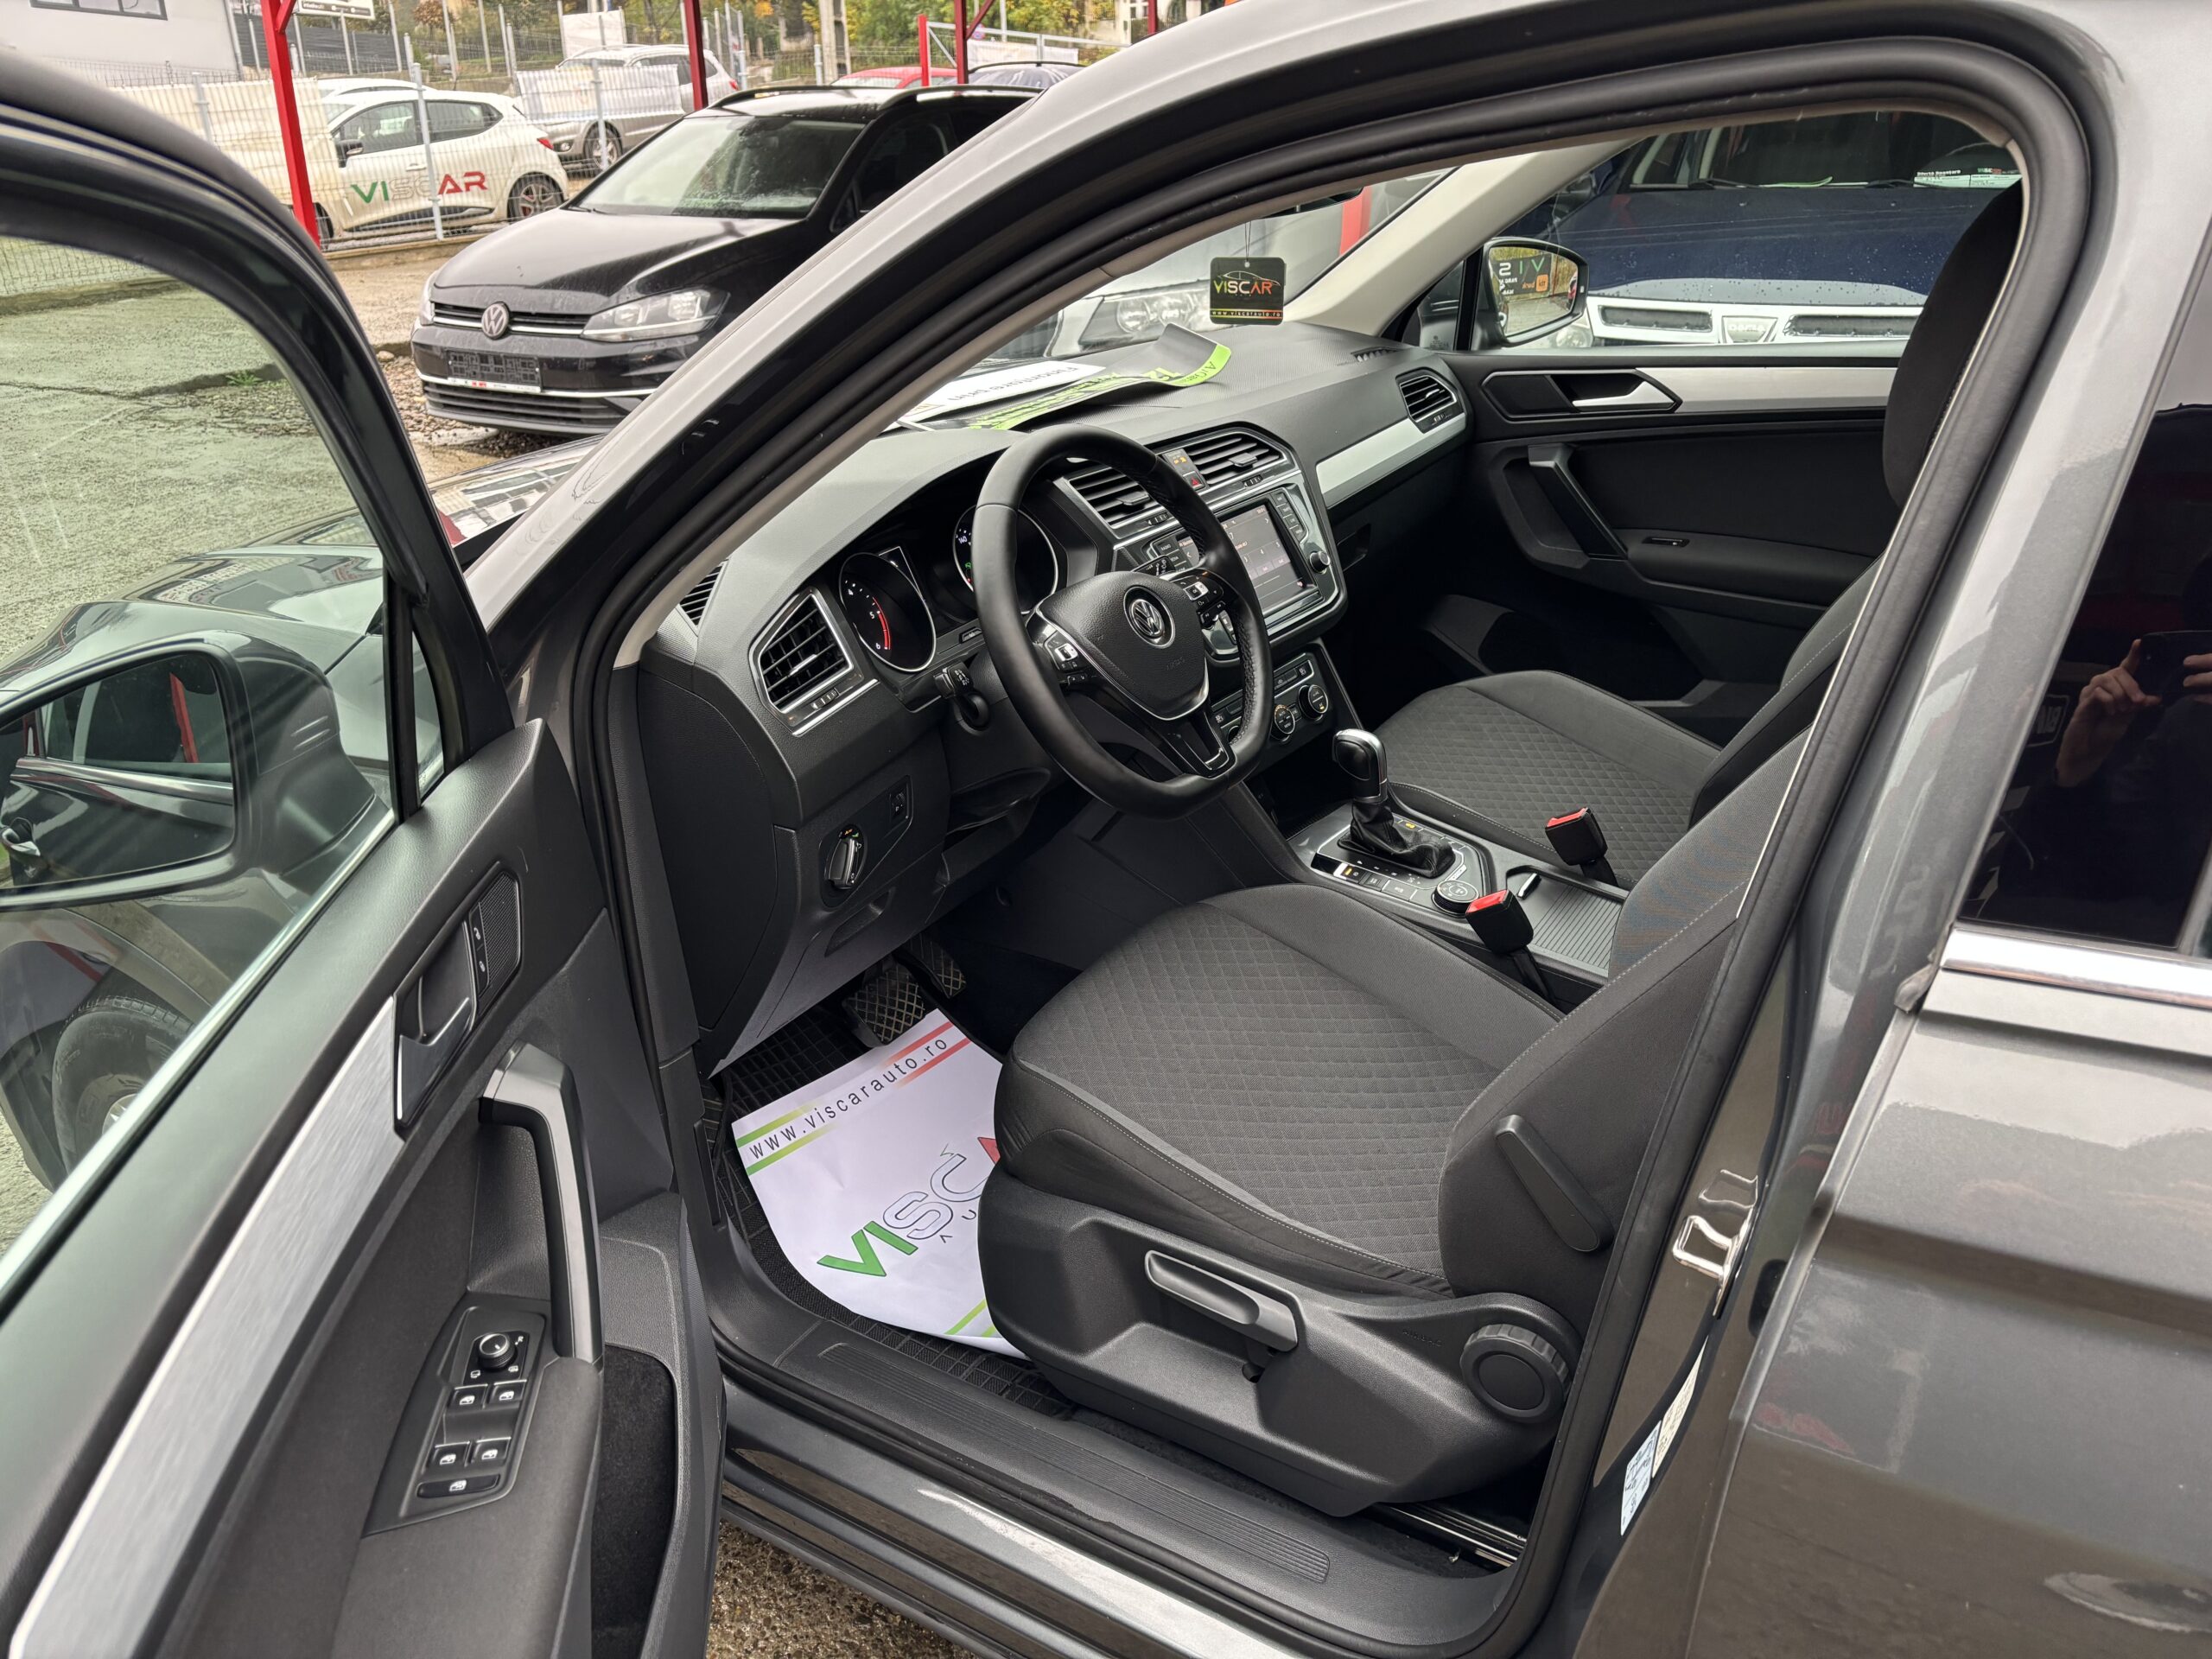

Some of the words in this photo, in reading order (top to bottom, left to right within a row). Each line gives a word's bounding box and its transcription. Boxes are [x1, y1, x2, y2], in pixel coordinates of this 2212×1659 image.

[350, 171, 488, 204] VISCAR
[1213, 279, 1273, 295] VISCAR
[749, 1039, 947, 1160] www.viscarauto.ro
[817, 1136, 1001, 1277] VISC
